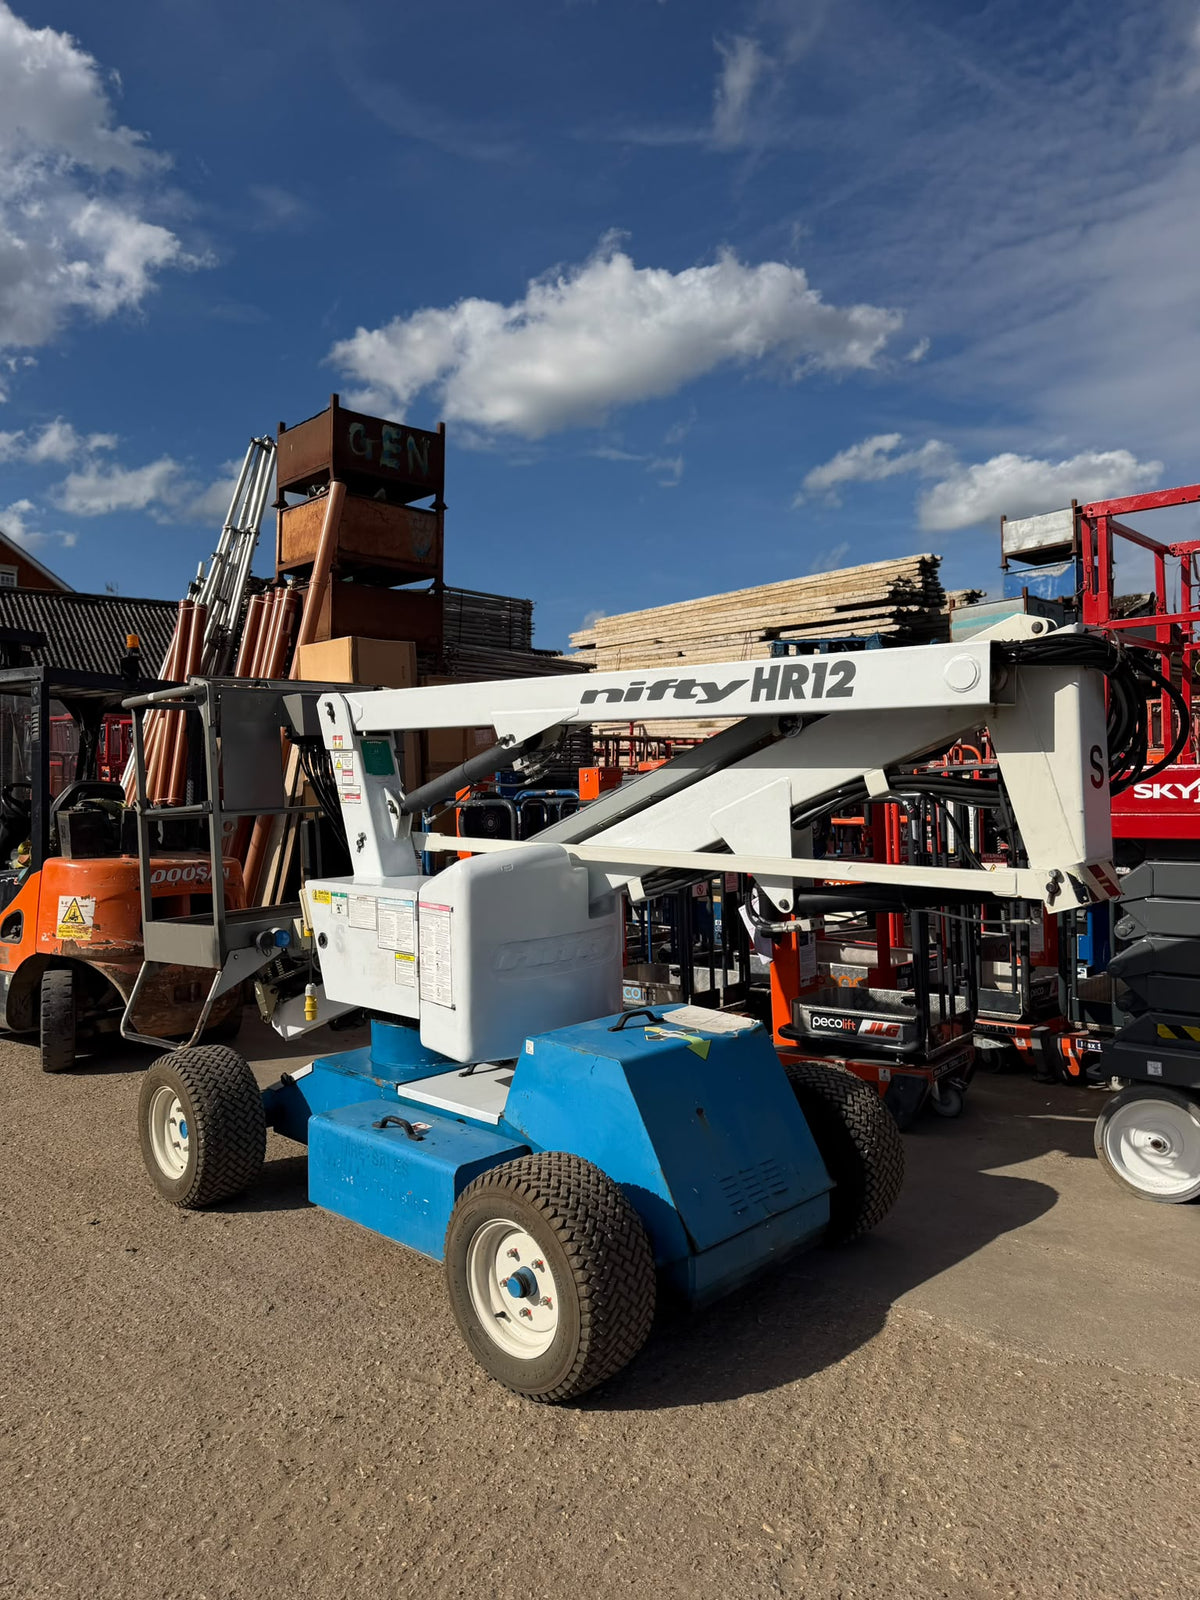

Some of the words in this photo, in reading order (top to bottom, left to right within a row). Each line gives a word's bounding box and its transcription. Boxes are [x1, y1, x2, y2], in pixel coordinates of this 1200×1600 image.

[348, 421, 431, 476] GEN
[580, 679, 750, 704] nifty
[750, 660, 856, 702] HR12
[1089, 745, 1104, 789] S
[812, 1015, 857, 1031] pecolift
[864, 1022, 901, 1038] JLG
